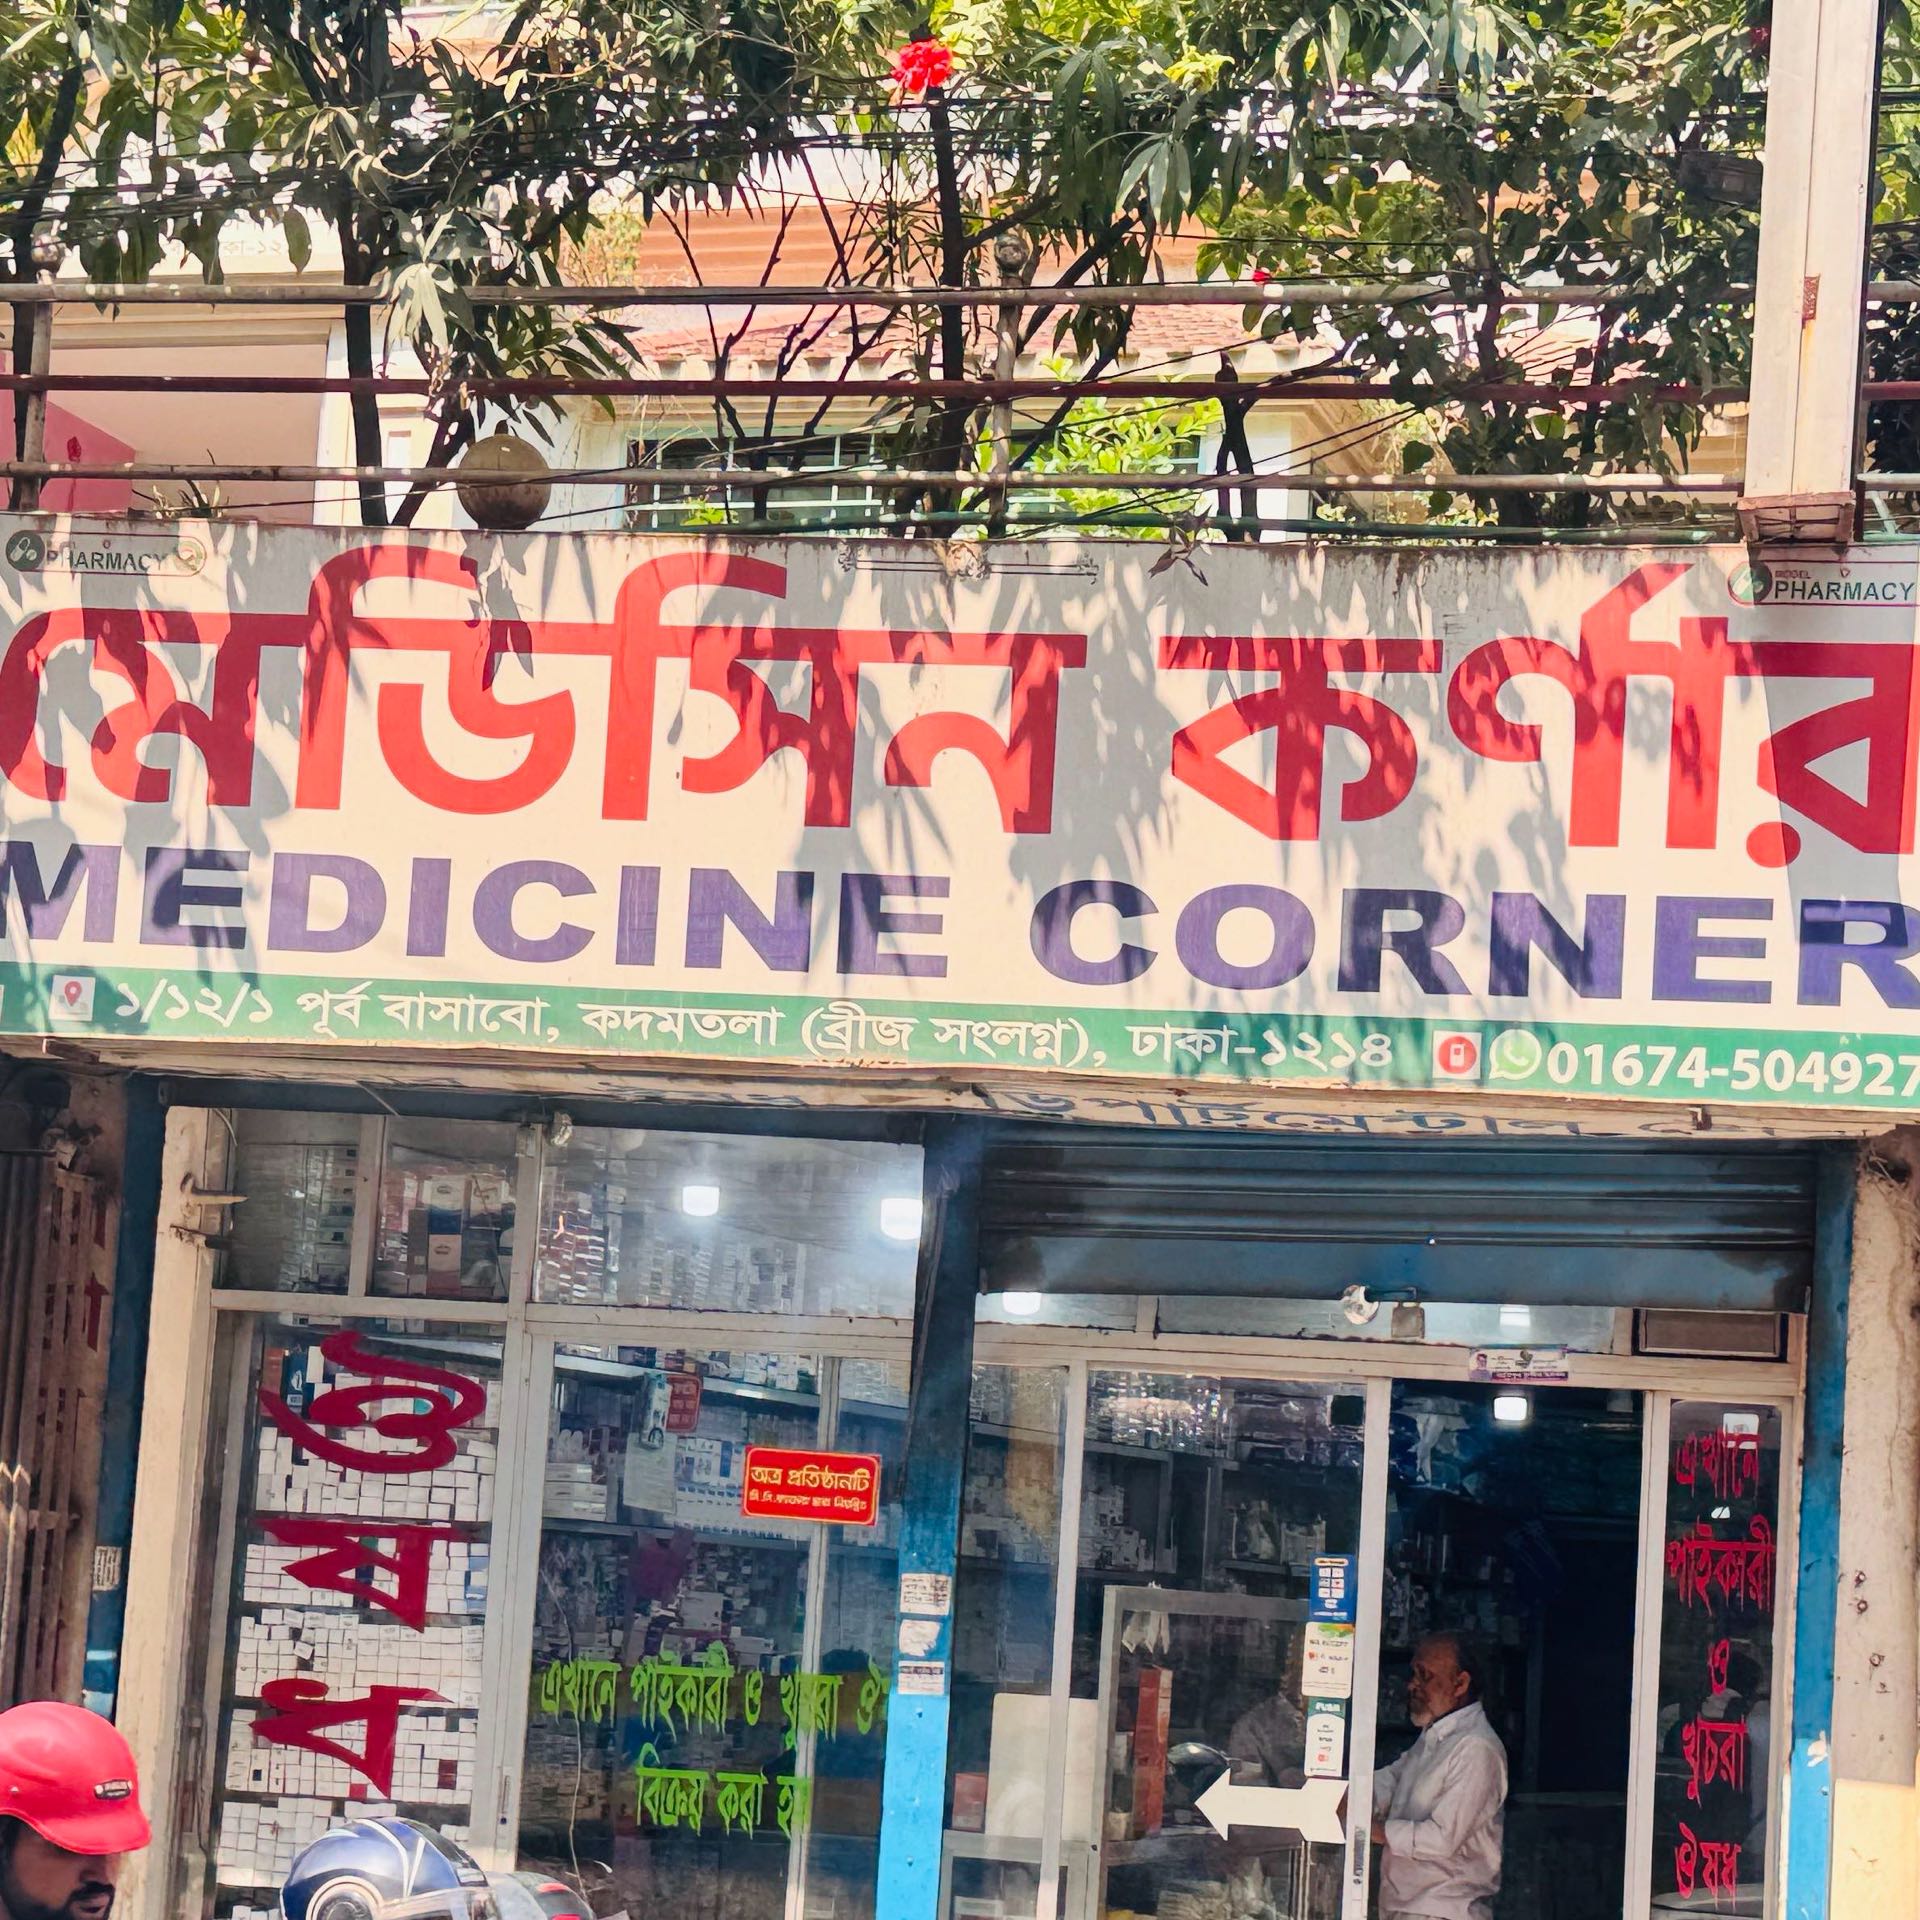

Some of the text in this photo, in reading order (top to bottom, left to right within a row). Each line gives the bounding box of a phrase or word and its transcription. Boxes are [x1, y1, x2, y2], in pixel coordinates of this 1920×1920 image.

[1775, 581, 1914, 601] PHARMACY
[0, 544, 1920, 868] মেডিসিন কর্ণার
[0, 841, 1920, 1010] MEDICINE CORNER
[116, 978, 1393, 1073] ১/১২/১ পূর্ব বাসাবো, কদমতলা (ব্রীজ সংলগ্ন), ঢাকা-১২১৪
[1547, 1043, 1920, 1098] 01674-504927
[751, 1464, 870, 1491] অত্র প্রতিষ্ঠানটি
[1676, 1426, 1763, 1500] এখানে
[1666, 1514, 1776, 1616] পাইকারী
[540, 1660, 622, 1728] এখানে
[717, 1771, 768, 1840] করা
